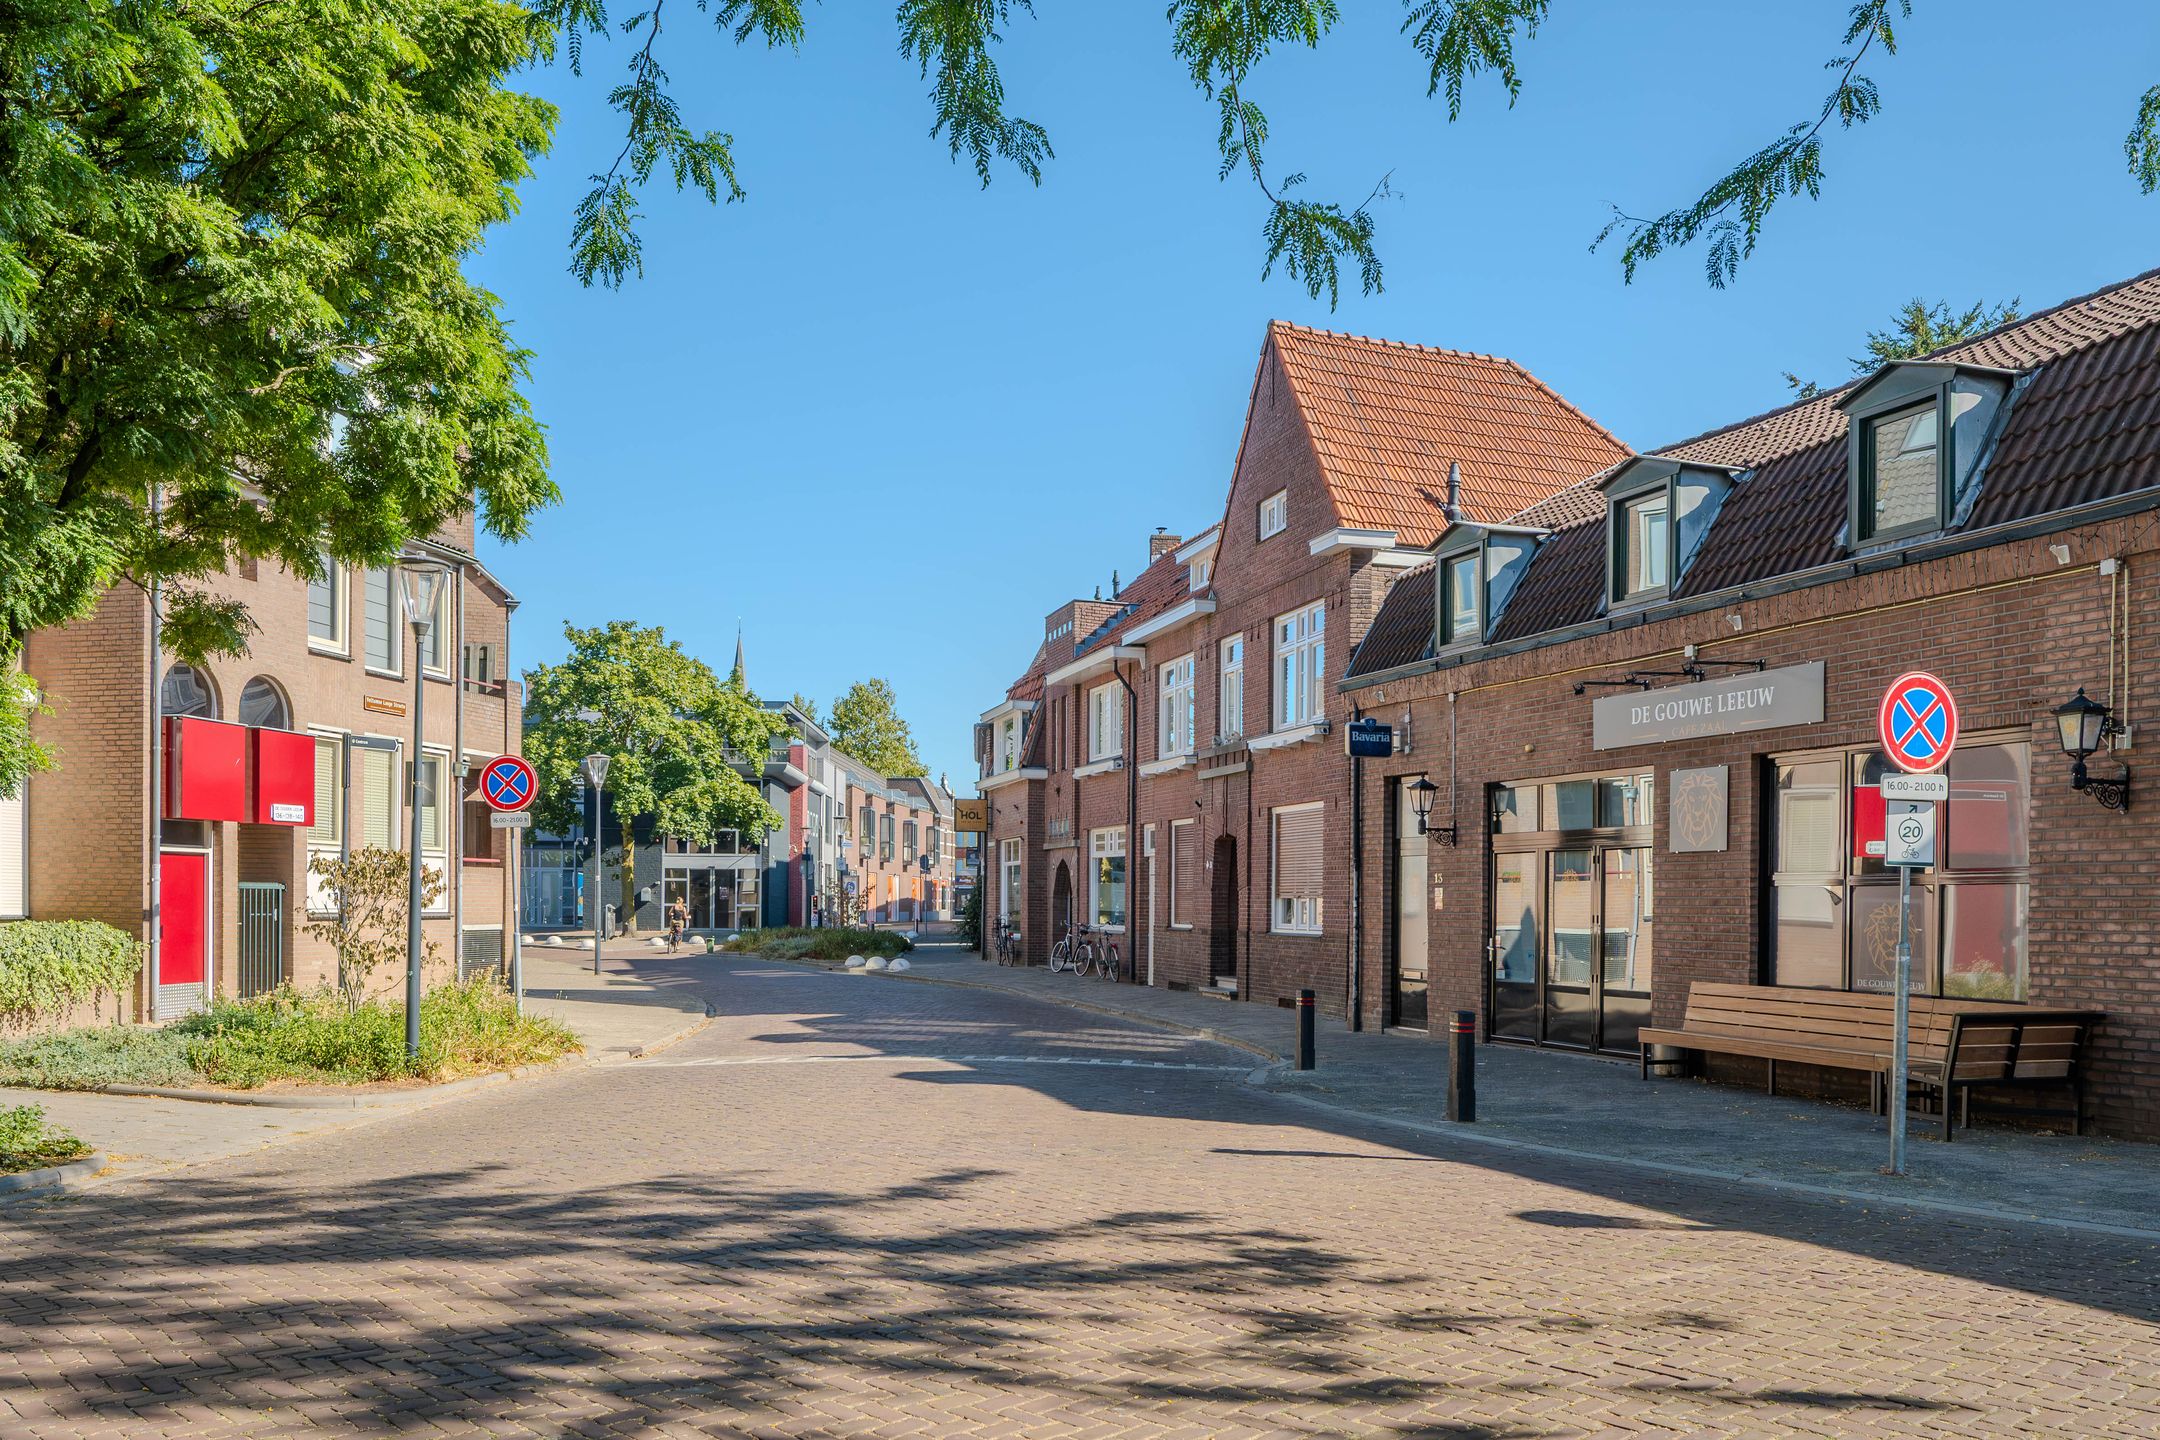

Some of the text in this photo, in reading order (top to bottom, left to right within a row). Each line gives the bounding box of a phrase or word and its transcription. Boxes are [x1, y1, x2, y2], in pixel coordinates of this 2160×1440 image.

[1631, 686, 1775, 725] DE GOUWE LEEUW
[1351, 731, 1391, 742] Bavaria
[1938, 783, 1944, 791] h
[960, 810, 983, 820] HOL
[1902, 826, 1921, 838] 20
